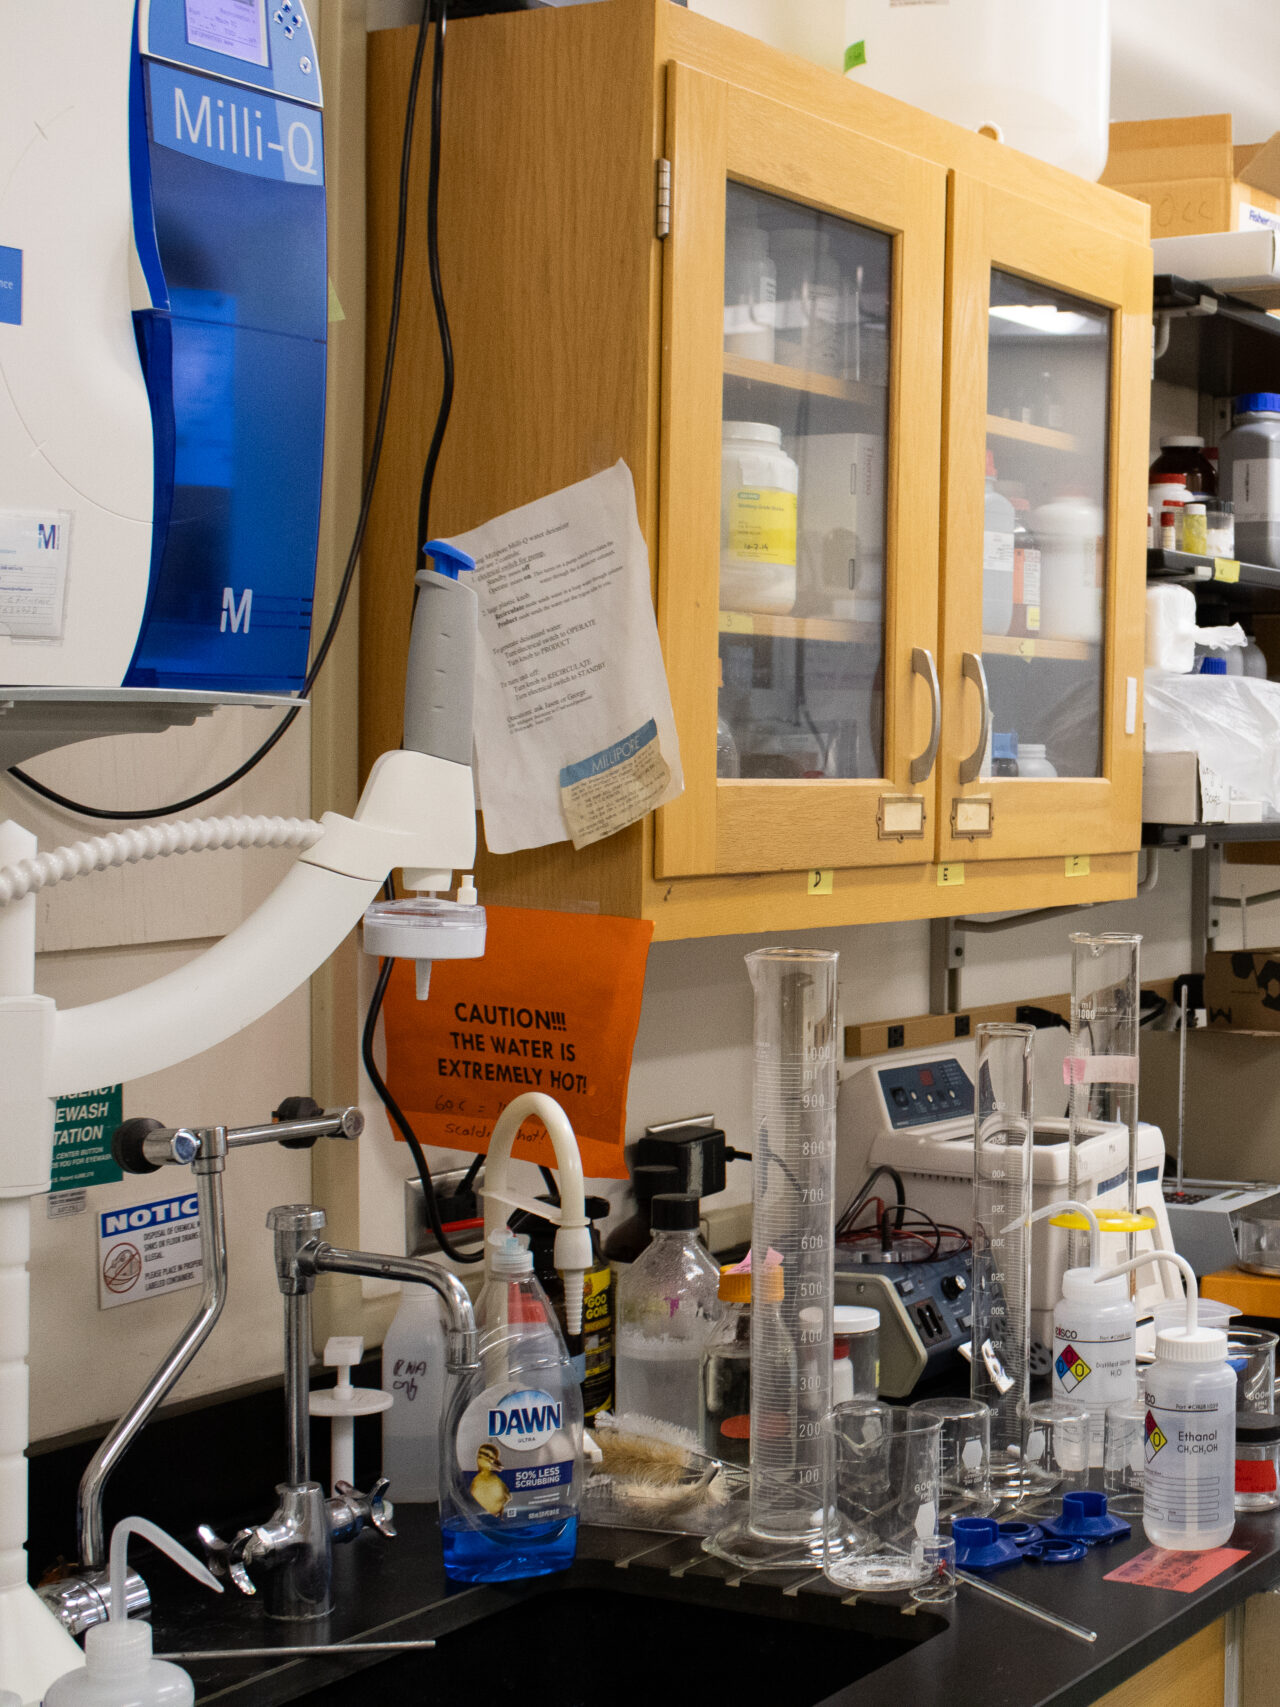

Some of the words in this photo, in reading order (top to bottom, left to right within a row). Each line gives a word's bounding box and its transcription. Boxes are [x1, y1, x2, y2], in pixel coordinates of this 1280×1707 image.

[173, 87, 318, 176] Milli-Q
[541, 638, 571, 655] PRODUCT
[591, 735, 641, 774] MILLIPORE
[813, 870, 822, 888] D
[943, 867, 949, 881] E
[455, 1002, 567, 1031] CAUTION!!!
[1077, 1008, 1095, 1020] 1000
[450, 1032, 485, 1051] THE
[490, 1035, 554, 1059] WATER
[561, 1043, 576, 1062] IS
[438, 1058, 543, 1086] EXTREMELY
[550, 1070, 587, 1095] HOT!
[803, 1094, 825, 1109] 900
[56, 1102, 109, 1123] EWASH
[53, 1125, 104, 1146] TATION
[56, 1150, 79, 1160] CENTER
[802, 1141, 824, 1156] 800
[60, 1160, 71, 1168] YOU
[802, 1188, 824, 1203] 700
[106, 1198, 198, 1234] NOTIC
[144, 1230, 165, 1240] DISPOSAL
[174, 1222, 195, 1232] CHEMICAL
[144, 1241, 157, 1252] SINKS
[166, 1236, 181, 1246] FLOOR
[181, 1232, 199, 1242] DRAINS
[801, 1235, 823, 1250] 600
[145, 1270, 161, 1280] PLEASE
[163, 1265, 176, 1275] PLACE
[145, 1279, 165, 1291] LABELED
[800, 1282, 822, 1297] 500
[588, 1293, 607, 1309] GOO
[585, 1304, 608, 1320] GONE
[800, 1329, 822, 1344] 400
[393, 1359, 427, 1377] RNA
[1075, 1364, 1084, 1377] 0
[1096, 1361, 1119, 1369] Distilled
[800, 1376, 821, 1391] 300
[488, 1403, 561, 1437] DAWN
[799, 1423, 821, 1438] 200
[1178, 1430, 1218, 1442] Ethanol
[518, 1436, 536, 1444] ULTRA
[1153, 1431, 1161, 1448] 0
[515, 1469, 537, 1482] 50%
[538, 1466, 560, 1479] LESS
[799, 1469, 819, 1484] 100
[515, 1475, 560, 1489] SCRUBBING
